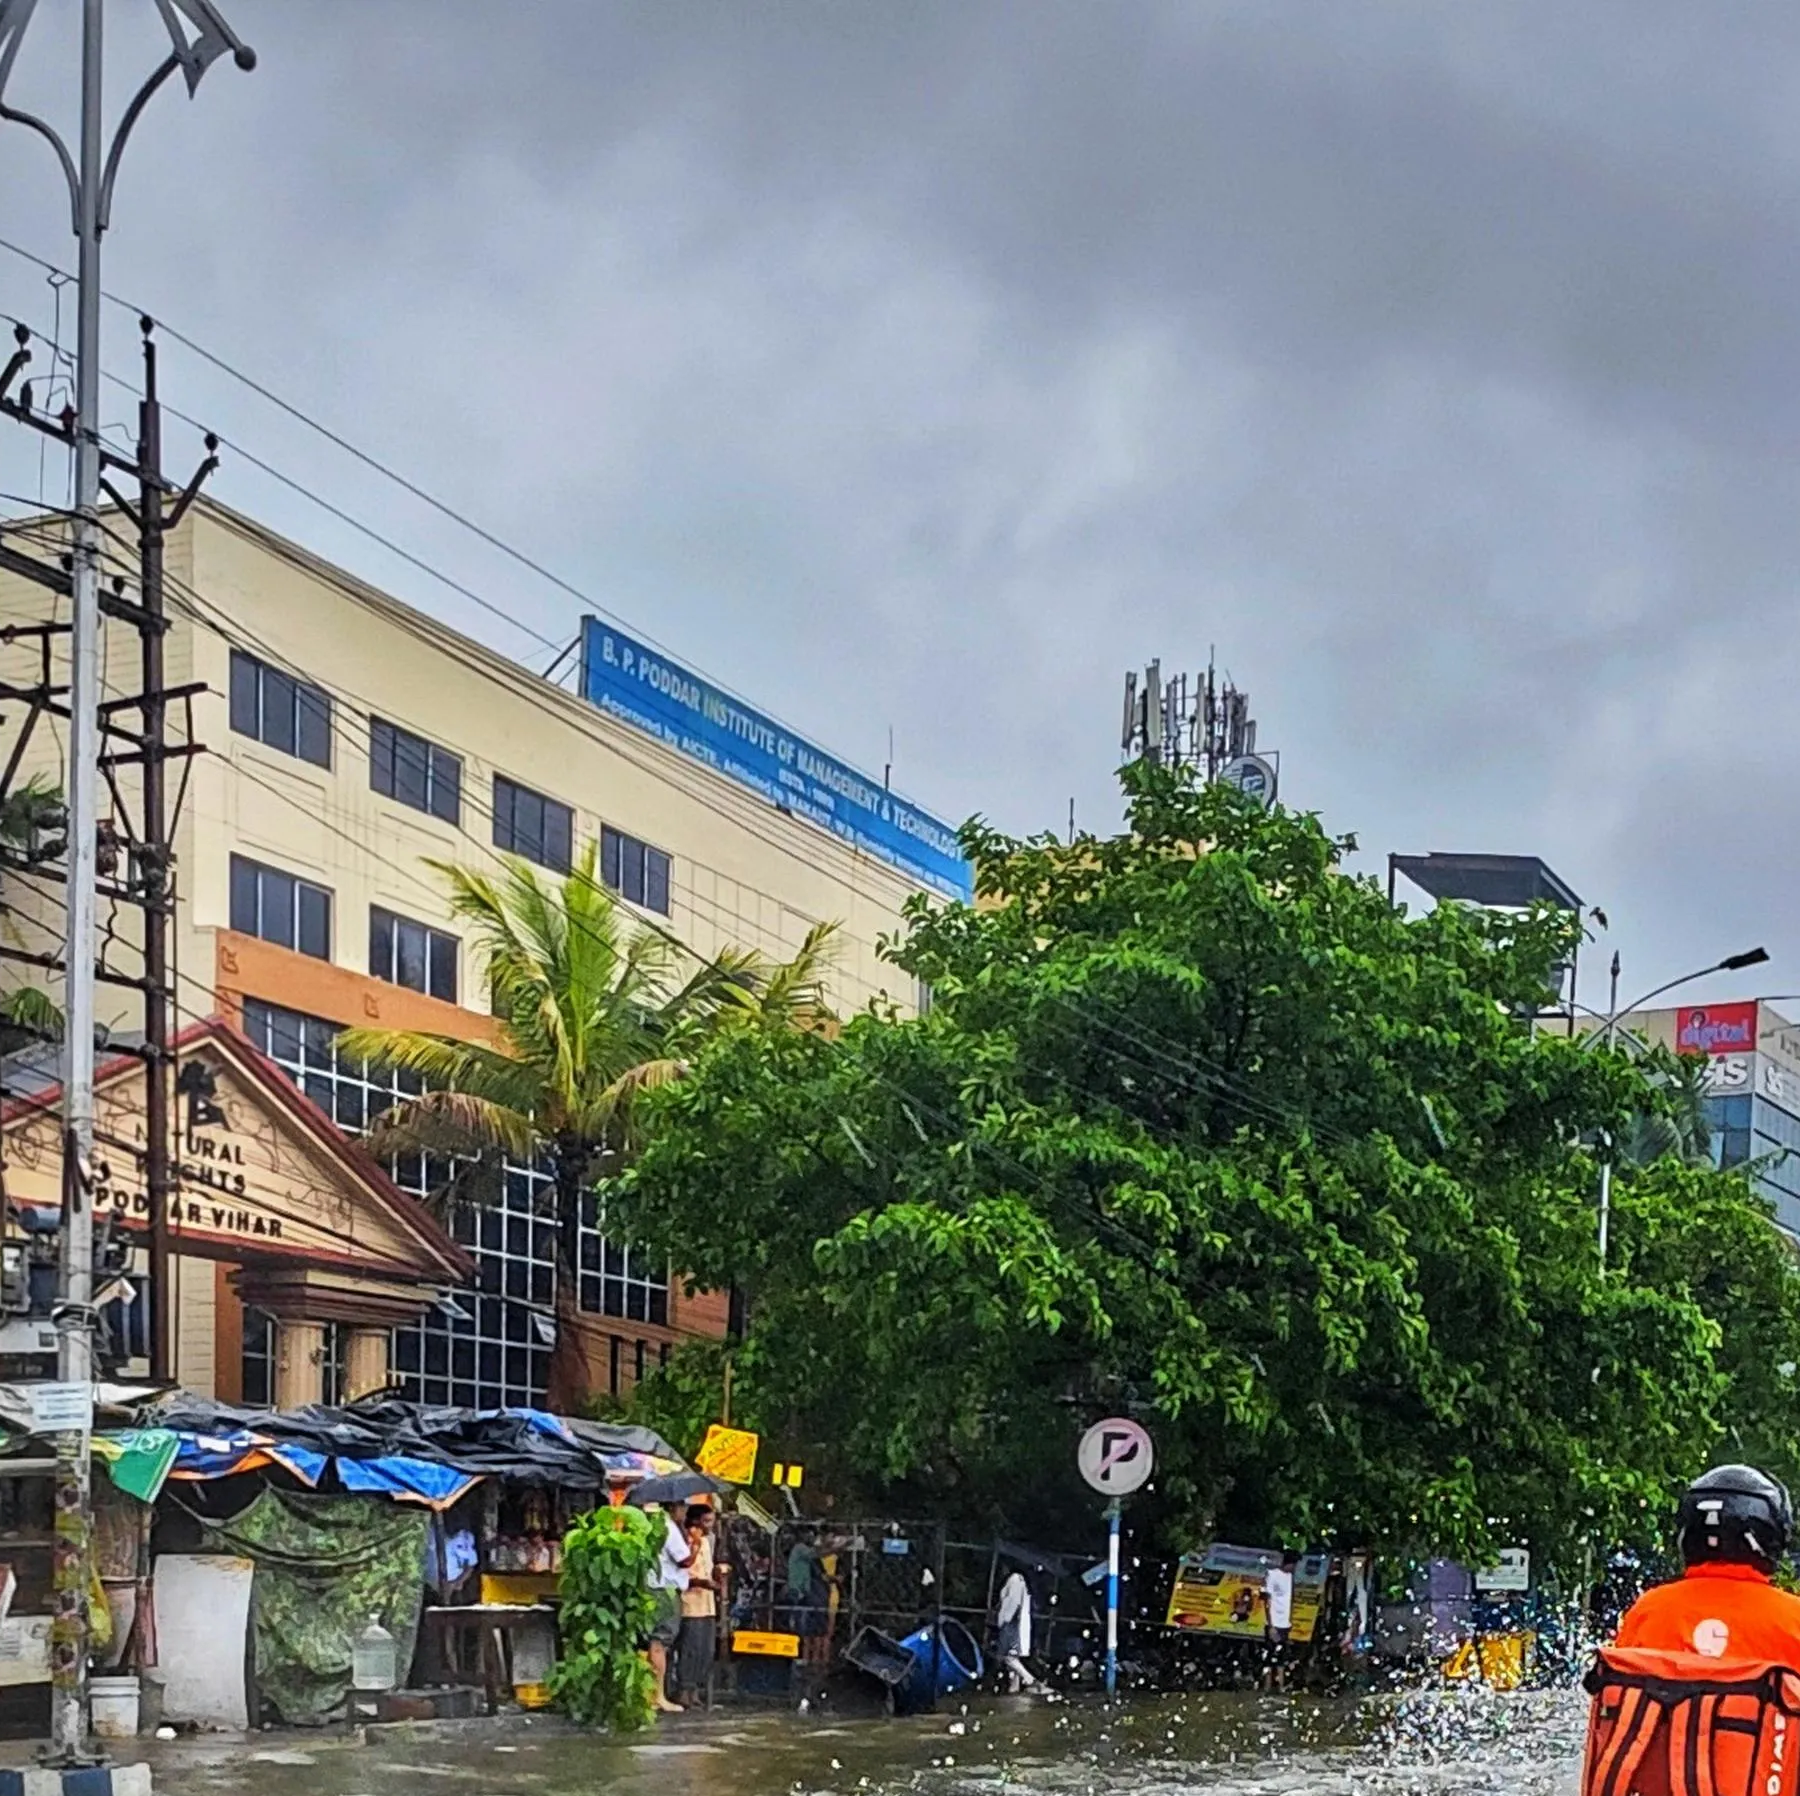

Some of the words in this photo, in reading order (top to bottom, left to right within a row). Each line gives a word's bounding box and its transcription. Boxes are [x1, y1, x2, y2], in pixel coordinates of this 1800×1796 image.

[622, 647, 636, 676] P.
[638, 656, 701, 712] PODDAR
[702, 693, 776, 755] INSTITUTE
[777, 738, 796, 765] OF
[797, 748, 881, 816] MANAGEMENT
[94, 1186, 202, 1223] PODAR
[211, 1207, 283, 1238] VIHAR
